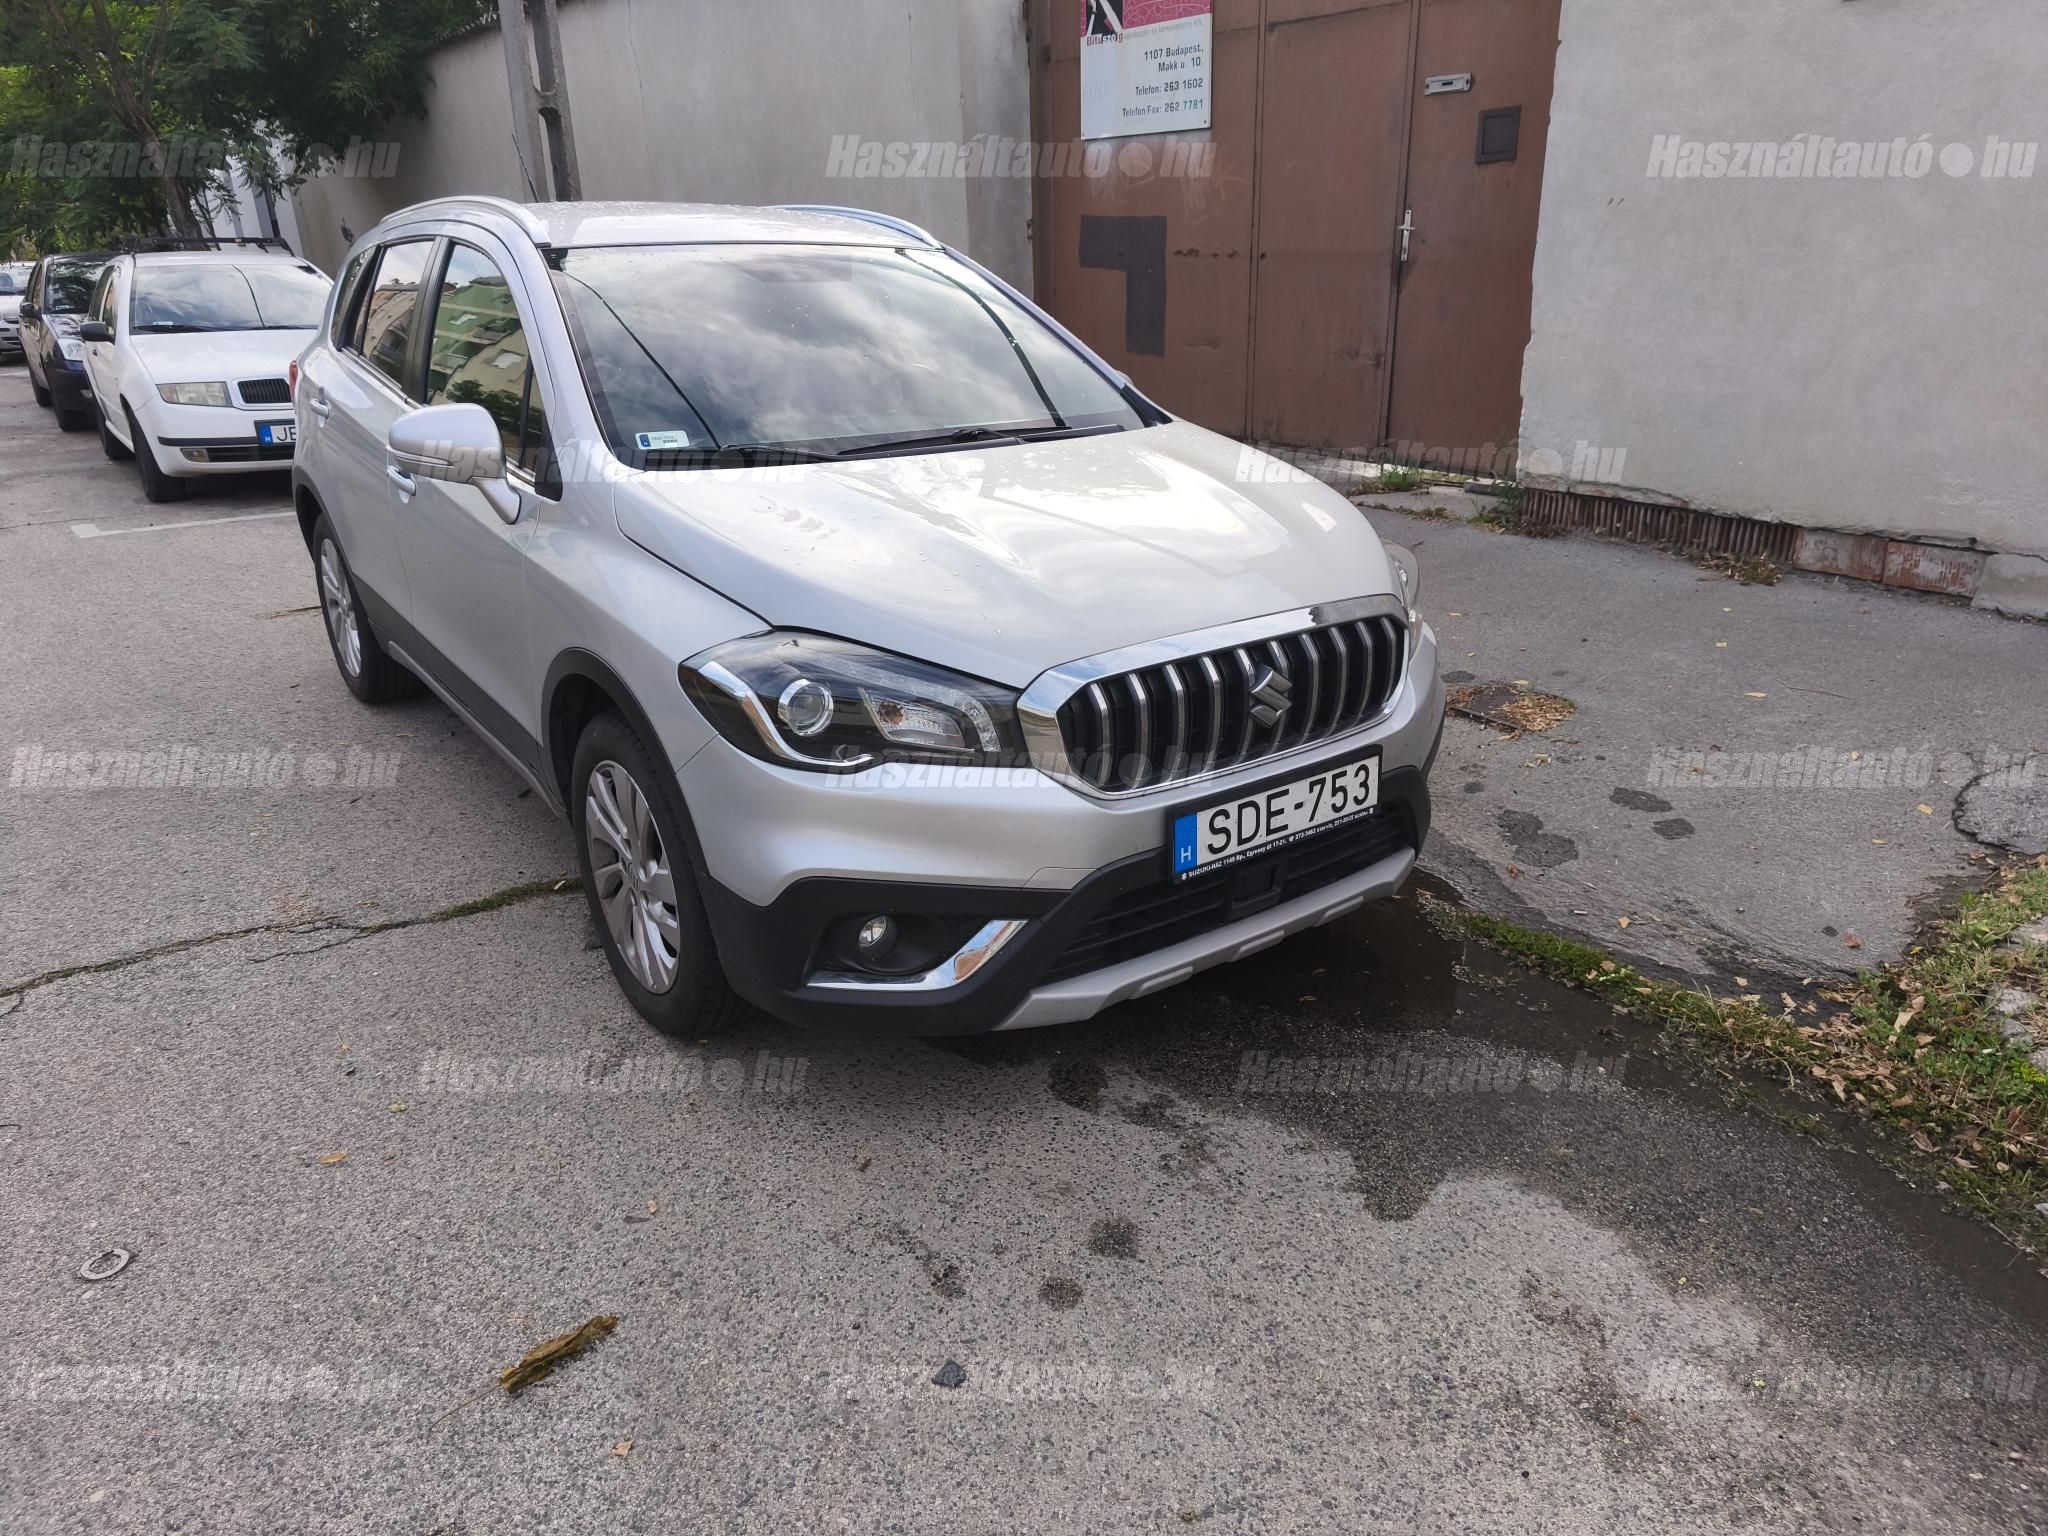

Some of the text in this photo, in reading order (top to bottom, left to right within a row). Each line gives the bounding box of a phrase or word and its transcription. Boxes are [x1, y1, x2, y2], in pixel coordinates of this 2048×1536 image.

[1144, 44, 1204, 61] 1107 Budapest,
[1158, 62, 1178, 72] Makk
[1191, 56, 1203, 67] 10.
[1135, 77, 1204, 96] Telefon: 263 1602
[1164, 101, 1180, 113] 262
[1207, 763, 1370, 854] SDE-753
[1181, 845, 1191, 863] H
